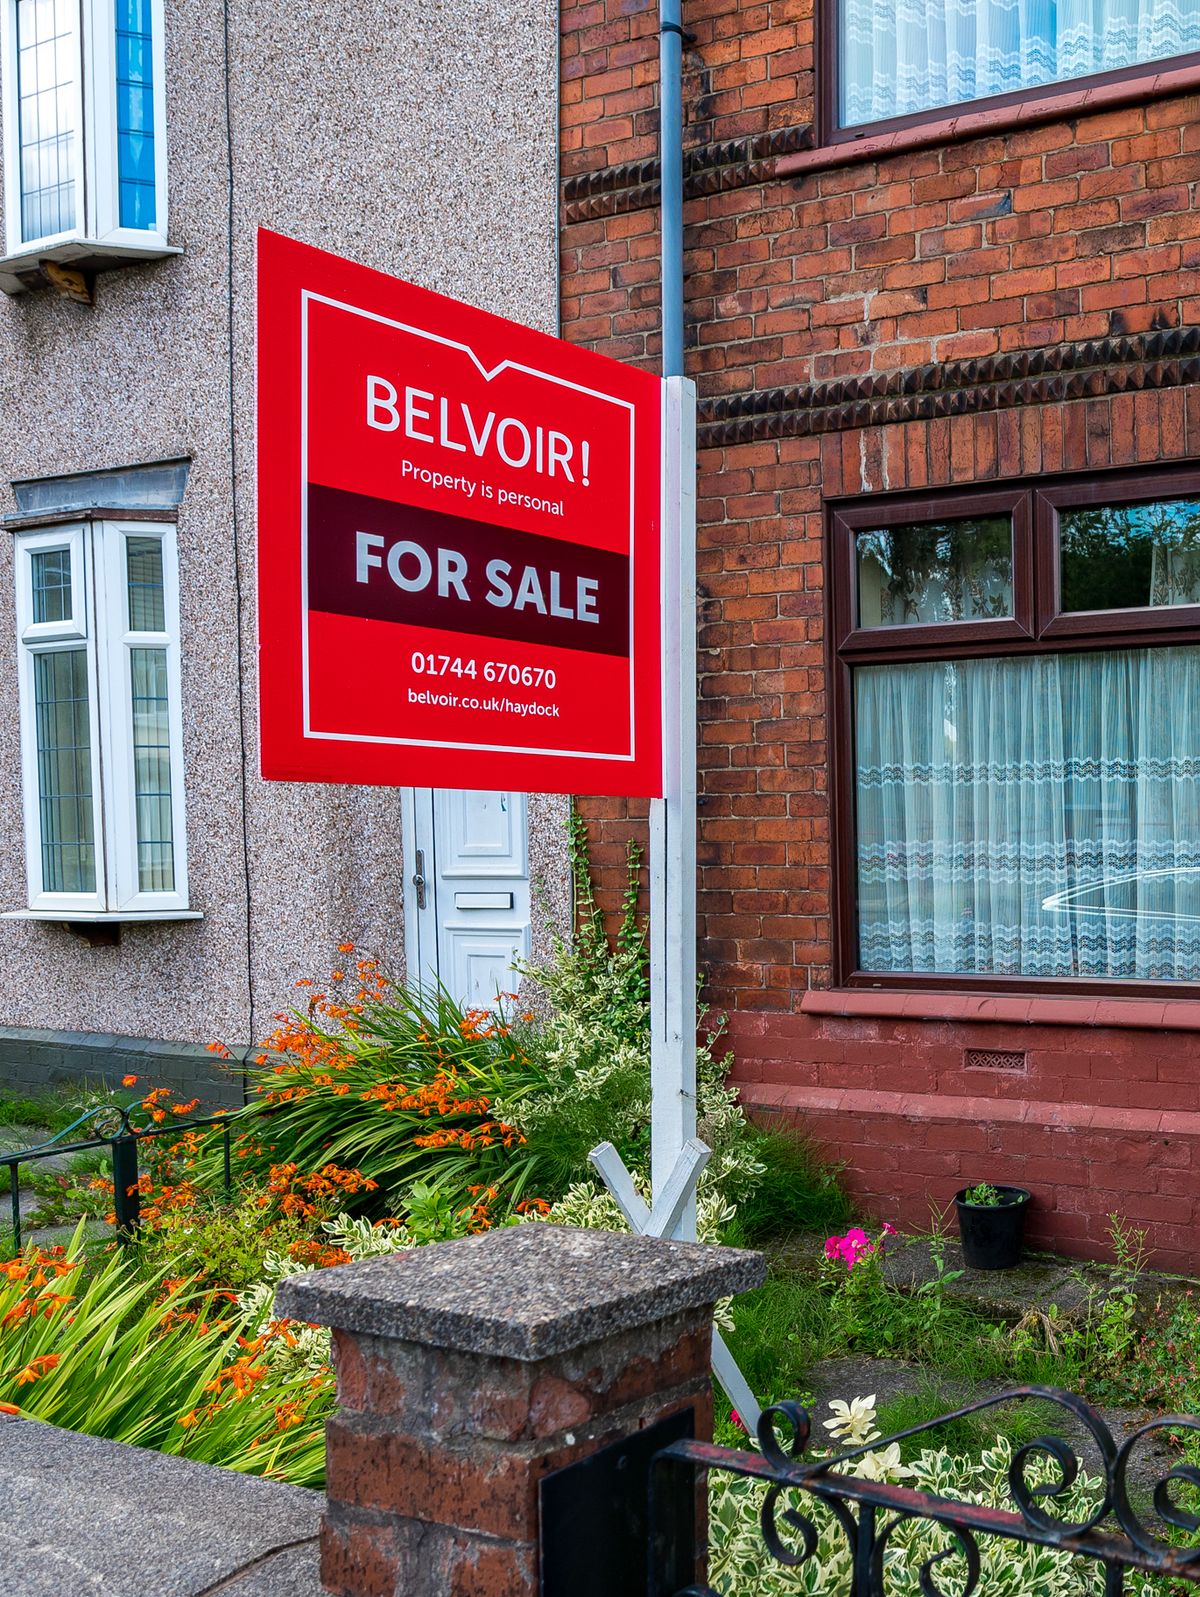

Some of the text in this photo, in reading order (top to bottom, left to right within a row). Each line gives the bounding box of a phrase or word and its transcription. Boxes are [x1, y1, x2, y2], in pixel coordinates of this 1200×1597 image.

[367, 374, 590, 487] BELVOIR!
[402, 460, 564, 517] Property is personal
[356, 531, 600, 624] FOR SALE
[411, 652, 557, 689] 01744 670670
[408, 688, 560, 717] belvoir.co.uk/haydock
